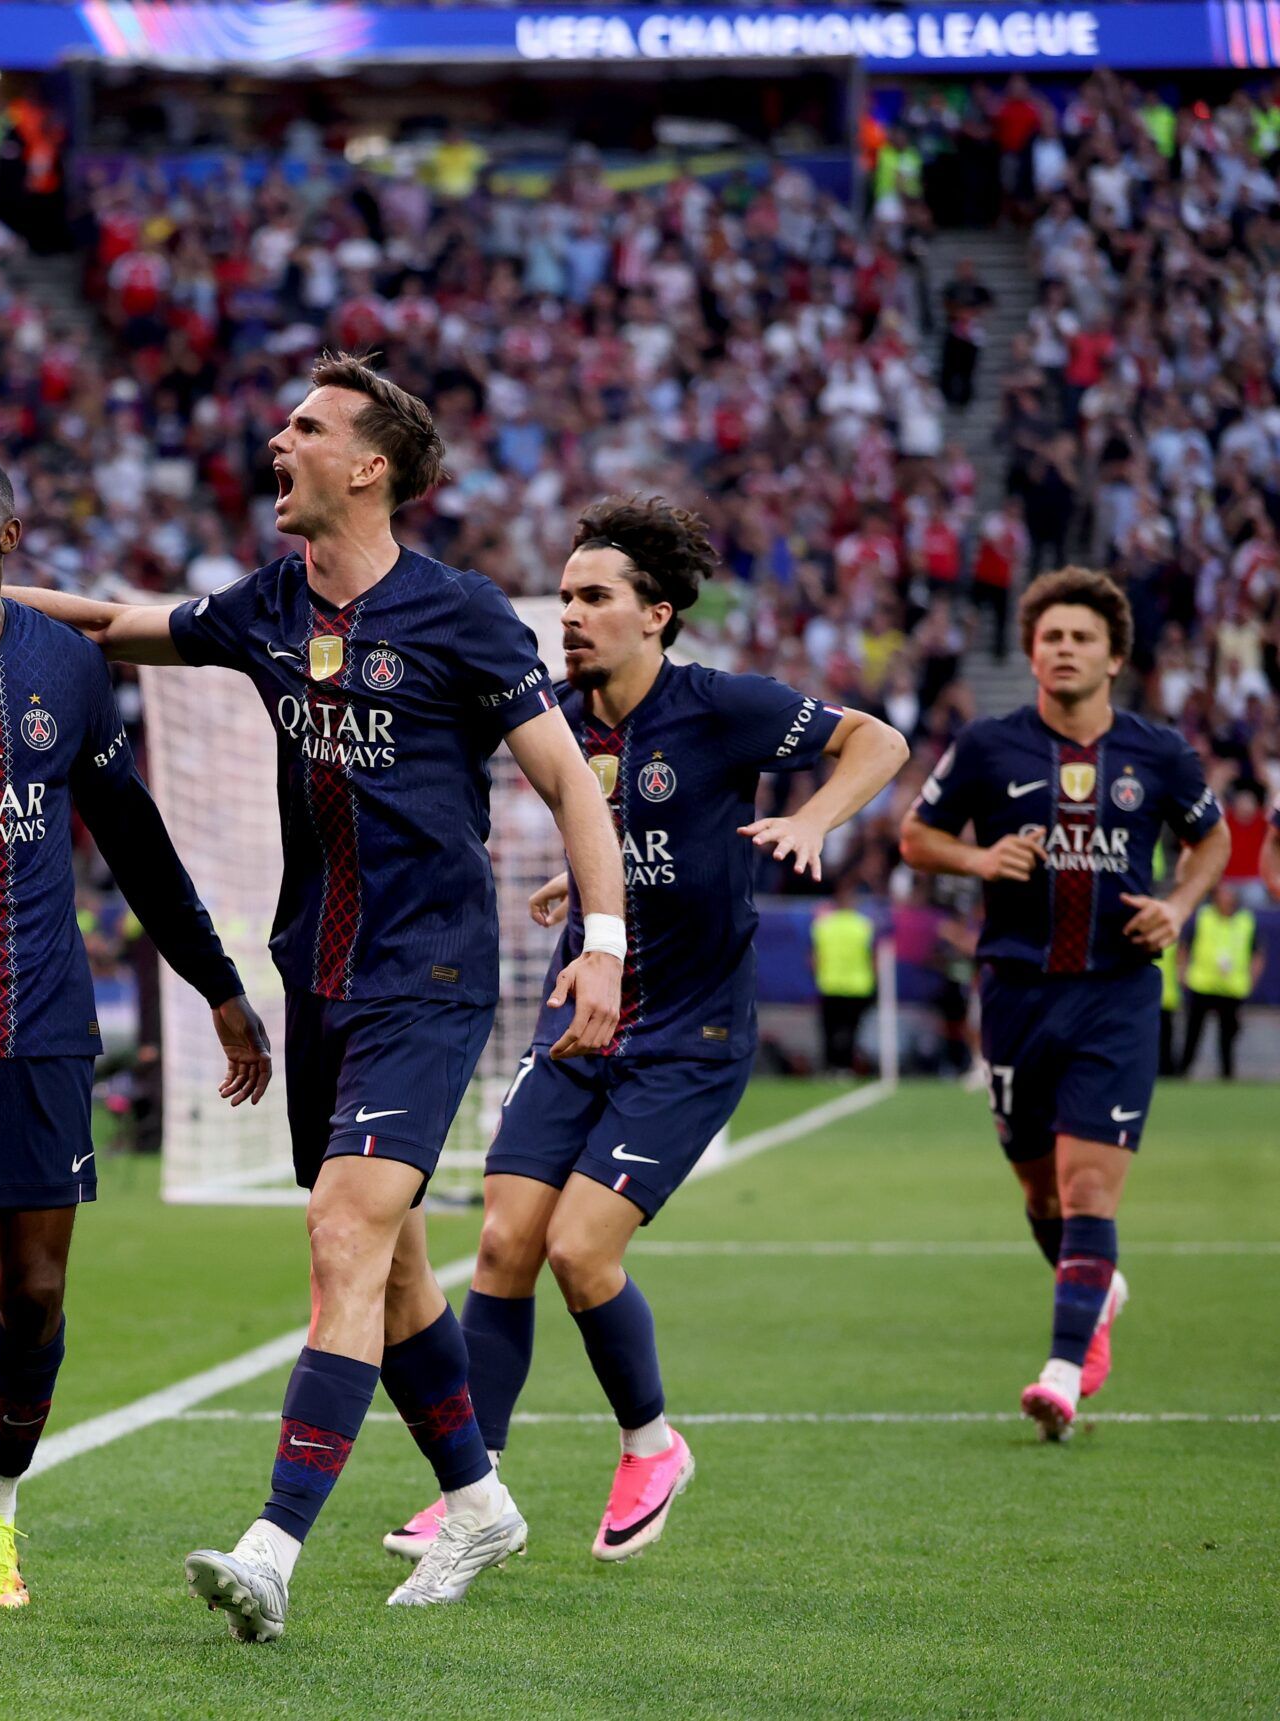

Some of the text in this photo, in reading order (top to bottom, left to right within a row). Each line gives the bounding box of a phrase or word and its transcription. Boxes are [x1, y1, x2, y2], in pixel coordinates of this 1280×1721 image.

[516, 12, 1098, 59] UEFA CHAMPIONS LEAGUE
[370, 651, 397, 661] PARIS
[25, 711, 50, 721] PARIS
[278, 695, 395, 743] QATAR
[94, 723, 127, 767] BEY
[301, 736, 396, 768] AIRWAYS
[643, 763, 669, 775] PARIS
[989, 1064, 1016, 1116] 7
